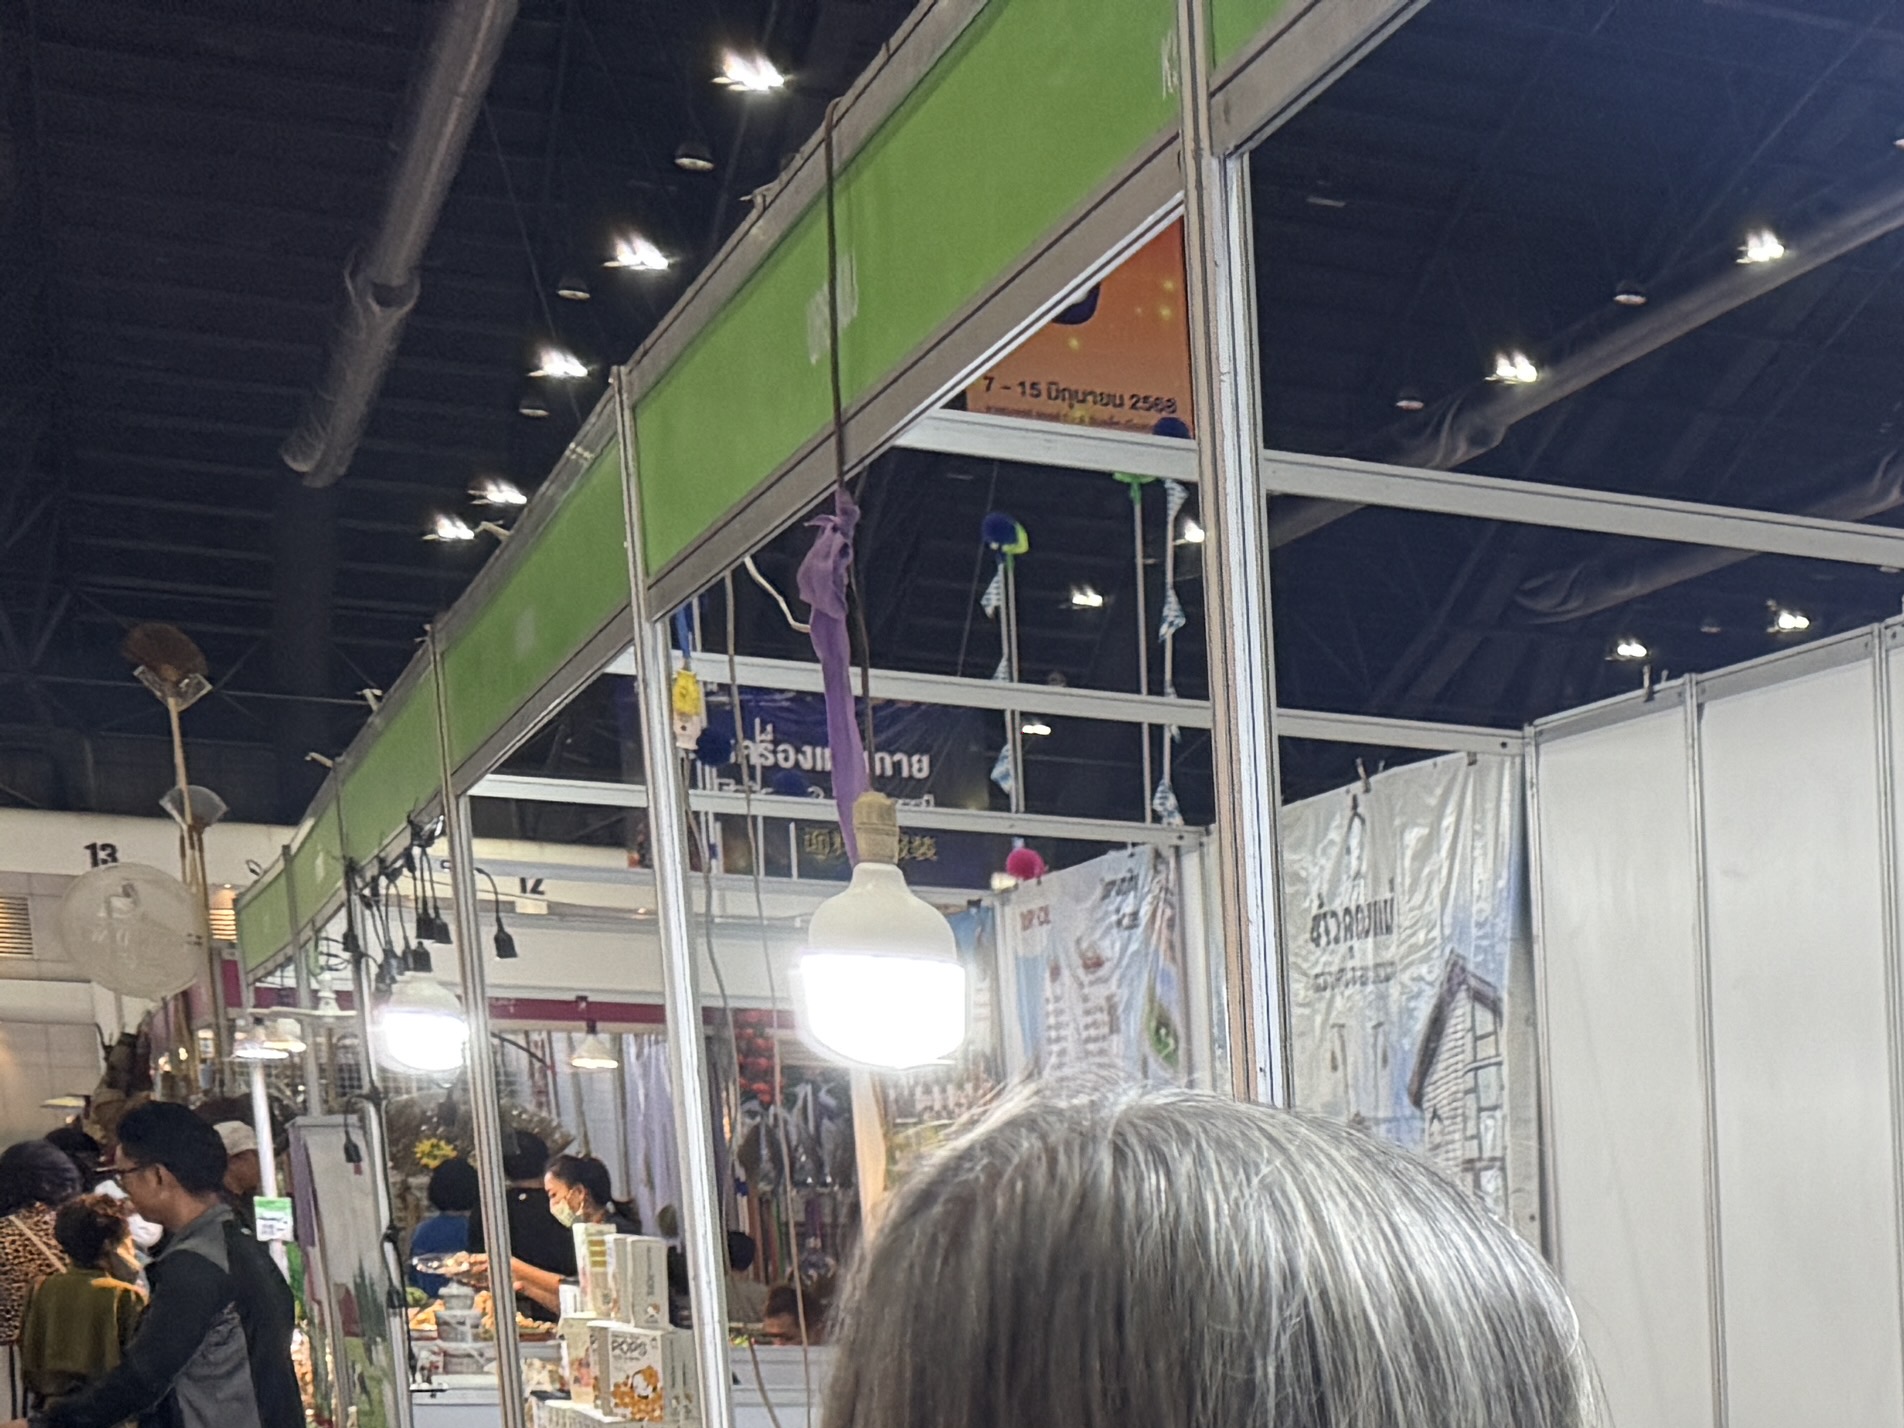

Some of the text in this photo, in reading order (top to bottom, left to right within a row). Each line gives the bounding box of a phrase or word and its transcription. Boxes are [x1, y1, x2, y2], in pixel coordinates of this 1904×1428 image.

[983, 377, 995, 392] 7
[1019, 382, 1041, 399] 15
[1129, 394, 1177, 414] 2568
